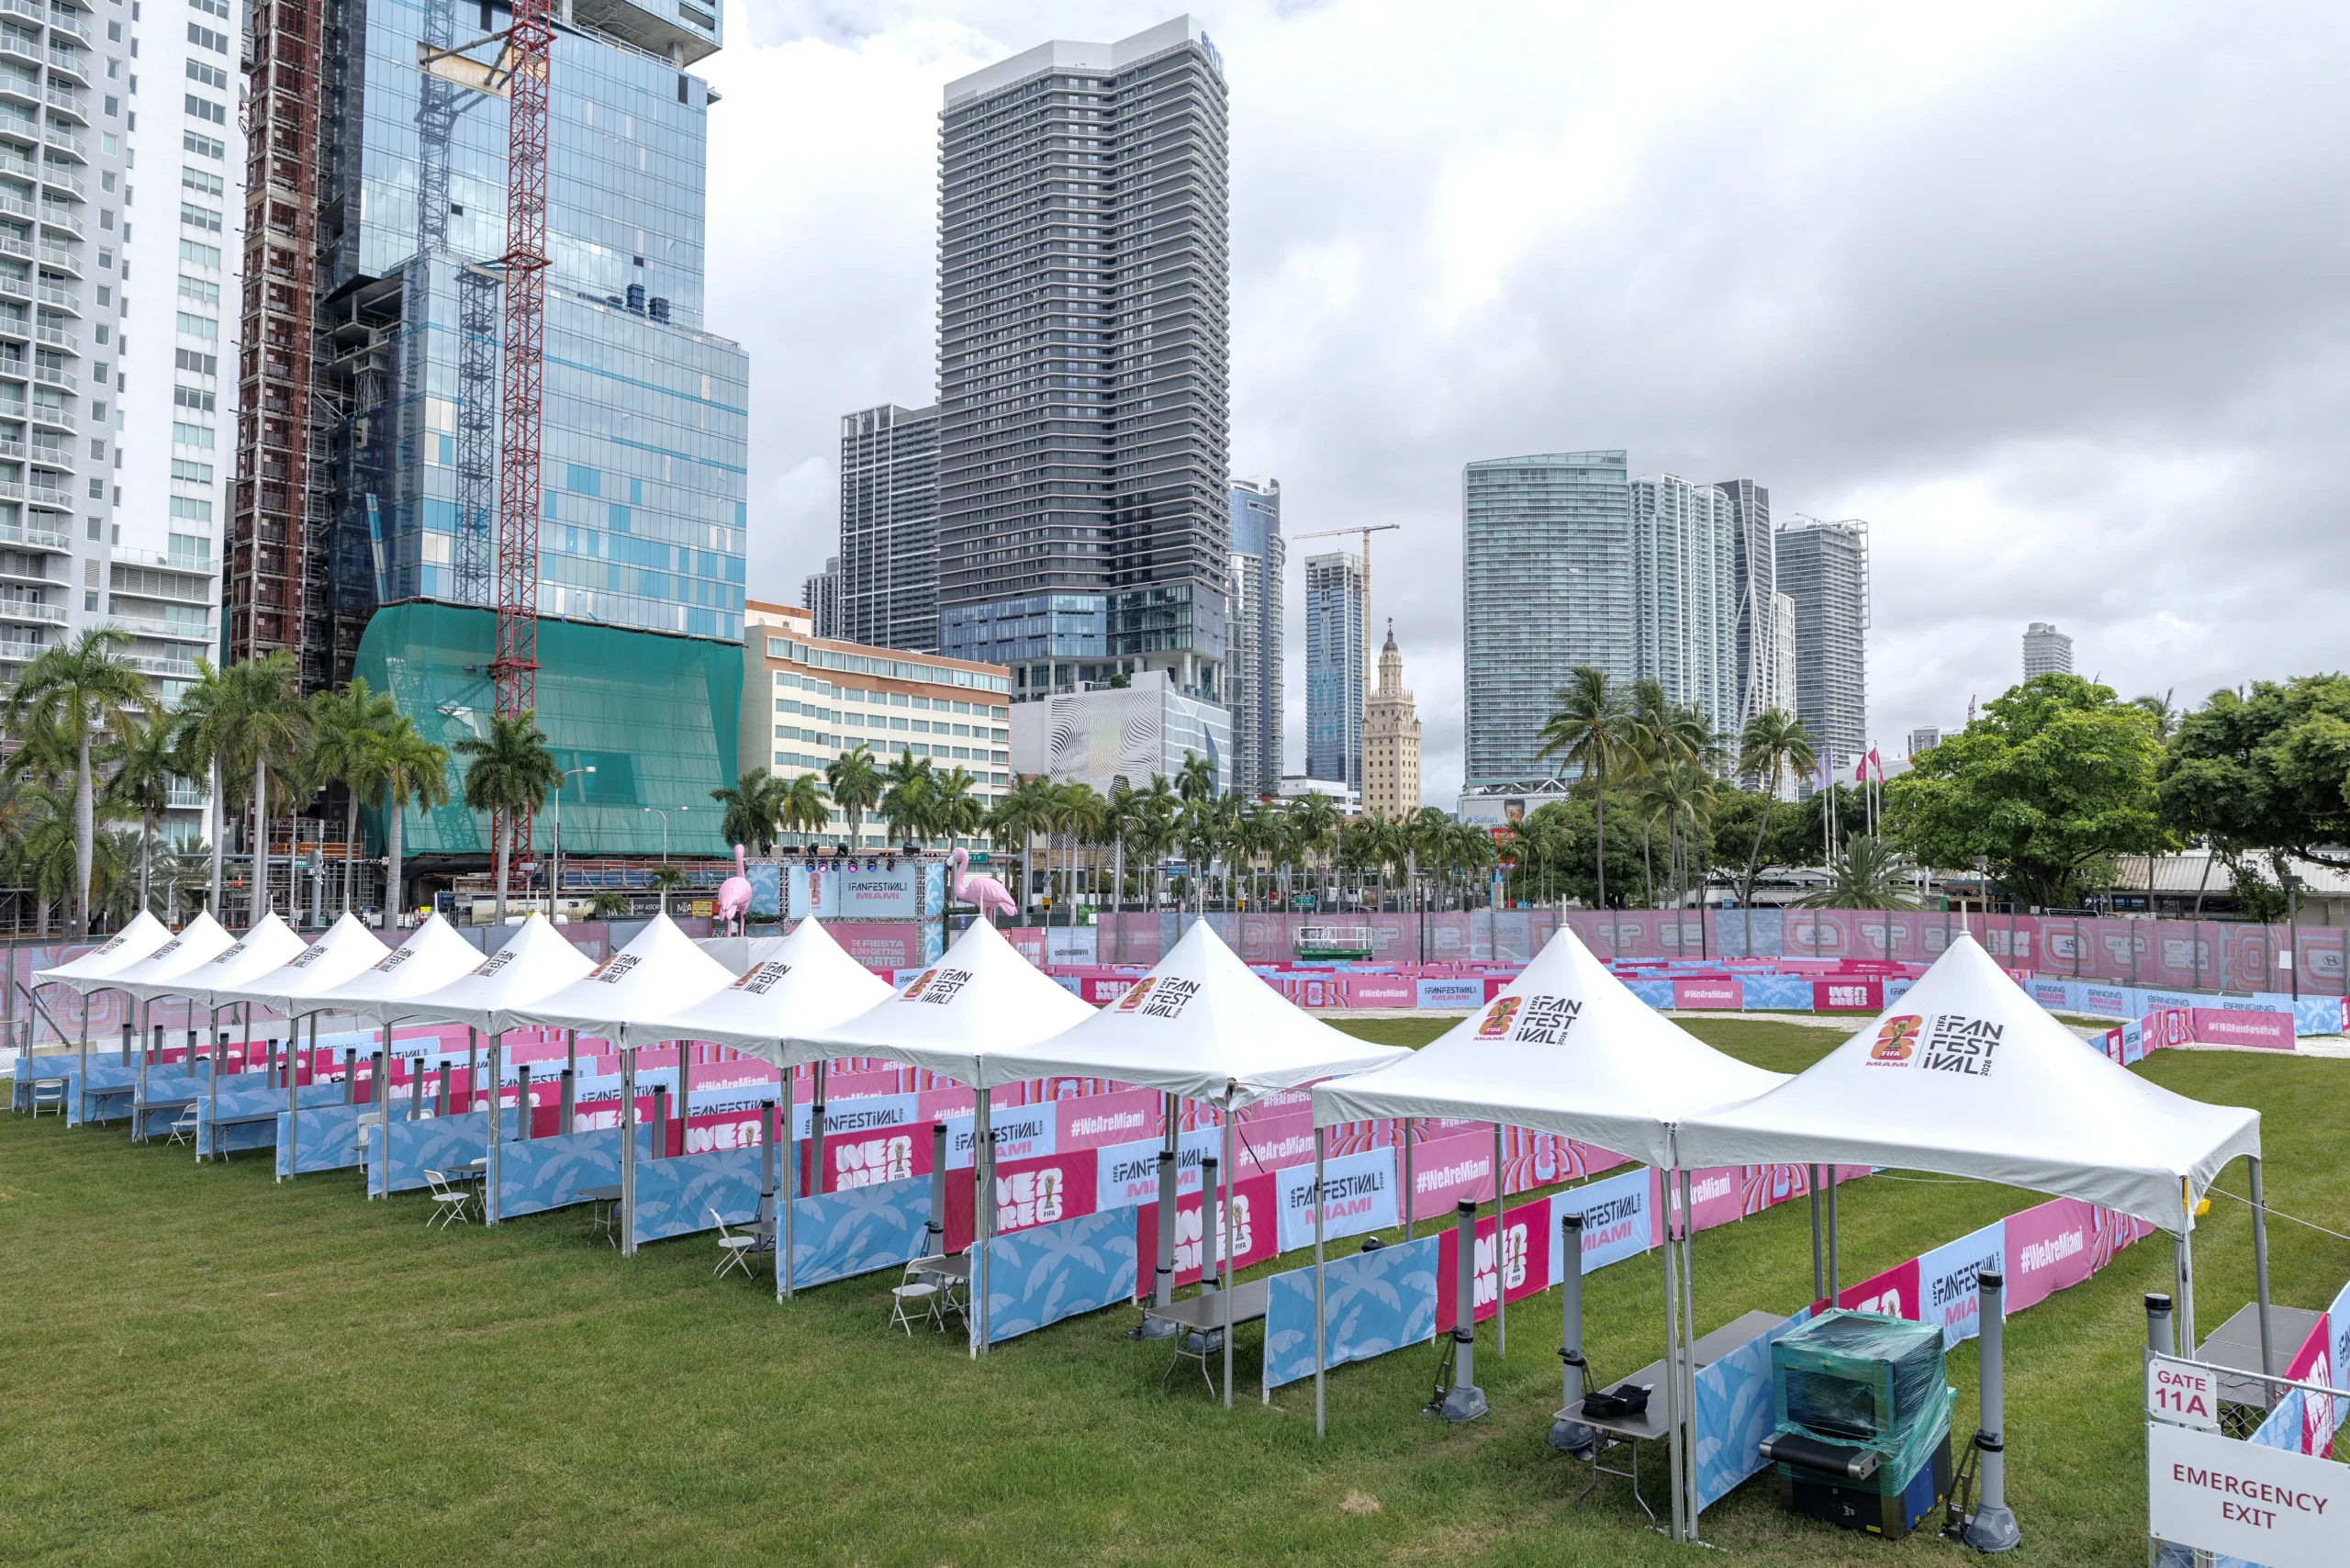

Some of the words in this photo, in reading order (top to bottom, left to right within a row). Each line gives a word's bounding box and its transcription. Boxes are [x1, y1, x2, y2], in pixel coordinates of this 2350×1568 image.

[1473, 815, 1498, 823] Safari
[619, 954, 643, 966] FAN
[606, 964, 633, 975] FEST
[767, 961, 791, 975] FAN
[754, 971, 782, 984] FEST
[944, 969, 973, 983] FAN
[930, 980, 965, 993] FEST
[1159, 977, 1171, 989] FIFA
[1167, 977, 1201, 995] FAN
[2035, 984, 2065, 993] BRINGING
[1151, 991, 1193, 1006] FEST
[1359, 990, 1408, 999] #WeAreMiami
[1684, 990, 1733, 999] #WeAreMiami
[2088, 990, 2122, 999] BRINGING
[2148, 995, 2189, 1006] BRINGING
[1529, 995, 1540, 1010] FIFA
[1538, 995, 1583, 1015] FAN
[2223, 1002, 2275, 1012] BRINGING
[1522, 1012, 1577, 1030] FEST
[1935, 1015, 1948, 1032] FIFA
[1946, 1015, 2003, 1039] FAN
[2209, 1023, 2280, 1036] #FIFAFanFestival
[1557, 1032, 1568, 1046] 2026
[1930, 1034, 1999, 1058] FEST
[1980, 1059, 1992, 1076] 2026
[1072, 1110, 1145, 1137] #WeAreMiami
[835, 1138, 887, 1173] WE
[1239, 1136, 1315, 1167] #WeAreMiam
[1416, 1157, 1491, 1193] #WeAreMiami
[1236, 1241, 1247, 1250] FIFA
[2021, 1226, 2084, 1274] #WeAreMiami
[1511, 1274, 1520, 1283] FIFA
[1944, 1295, 1979, 1327] MIA
[2157, 1370, 2207, 1392] GATE
[2155, 1388, 2209, 1417] 11A
[2174, 1463, 2328, 1515] EMERGENCY
[2223, 1502, 2277, 1529] EXIT
